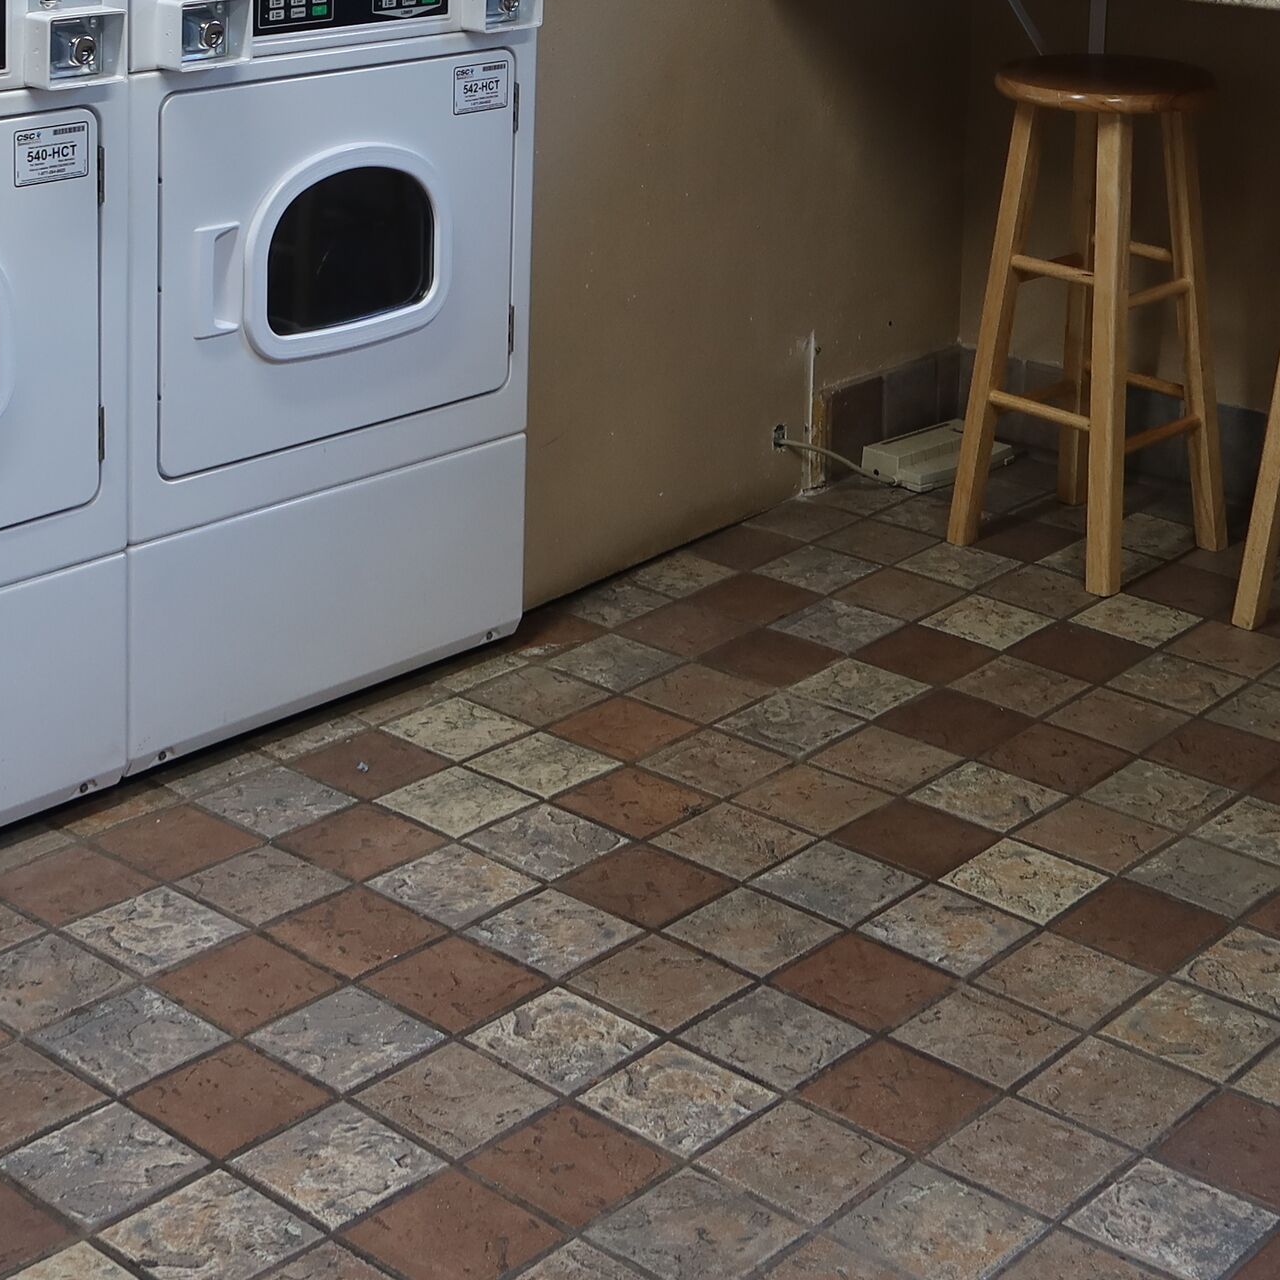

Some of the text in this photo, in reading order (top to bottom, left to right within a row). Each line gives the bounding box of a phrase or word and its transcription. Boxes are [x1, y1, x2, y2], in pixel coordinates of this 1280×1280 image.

[464, 80, 500, 94] 542-HCT
[17, 133, 35, 141] CSC
[27, 144, 77, 162] 540-HCT
